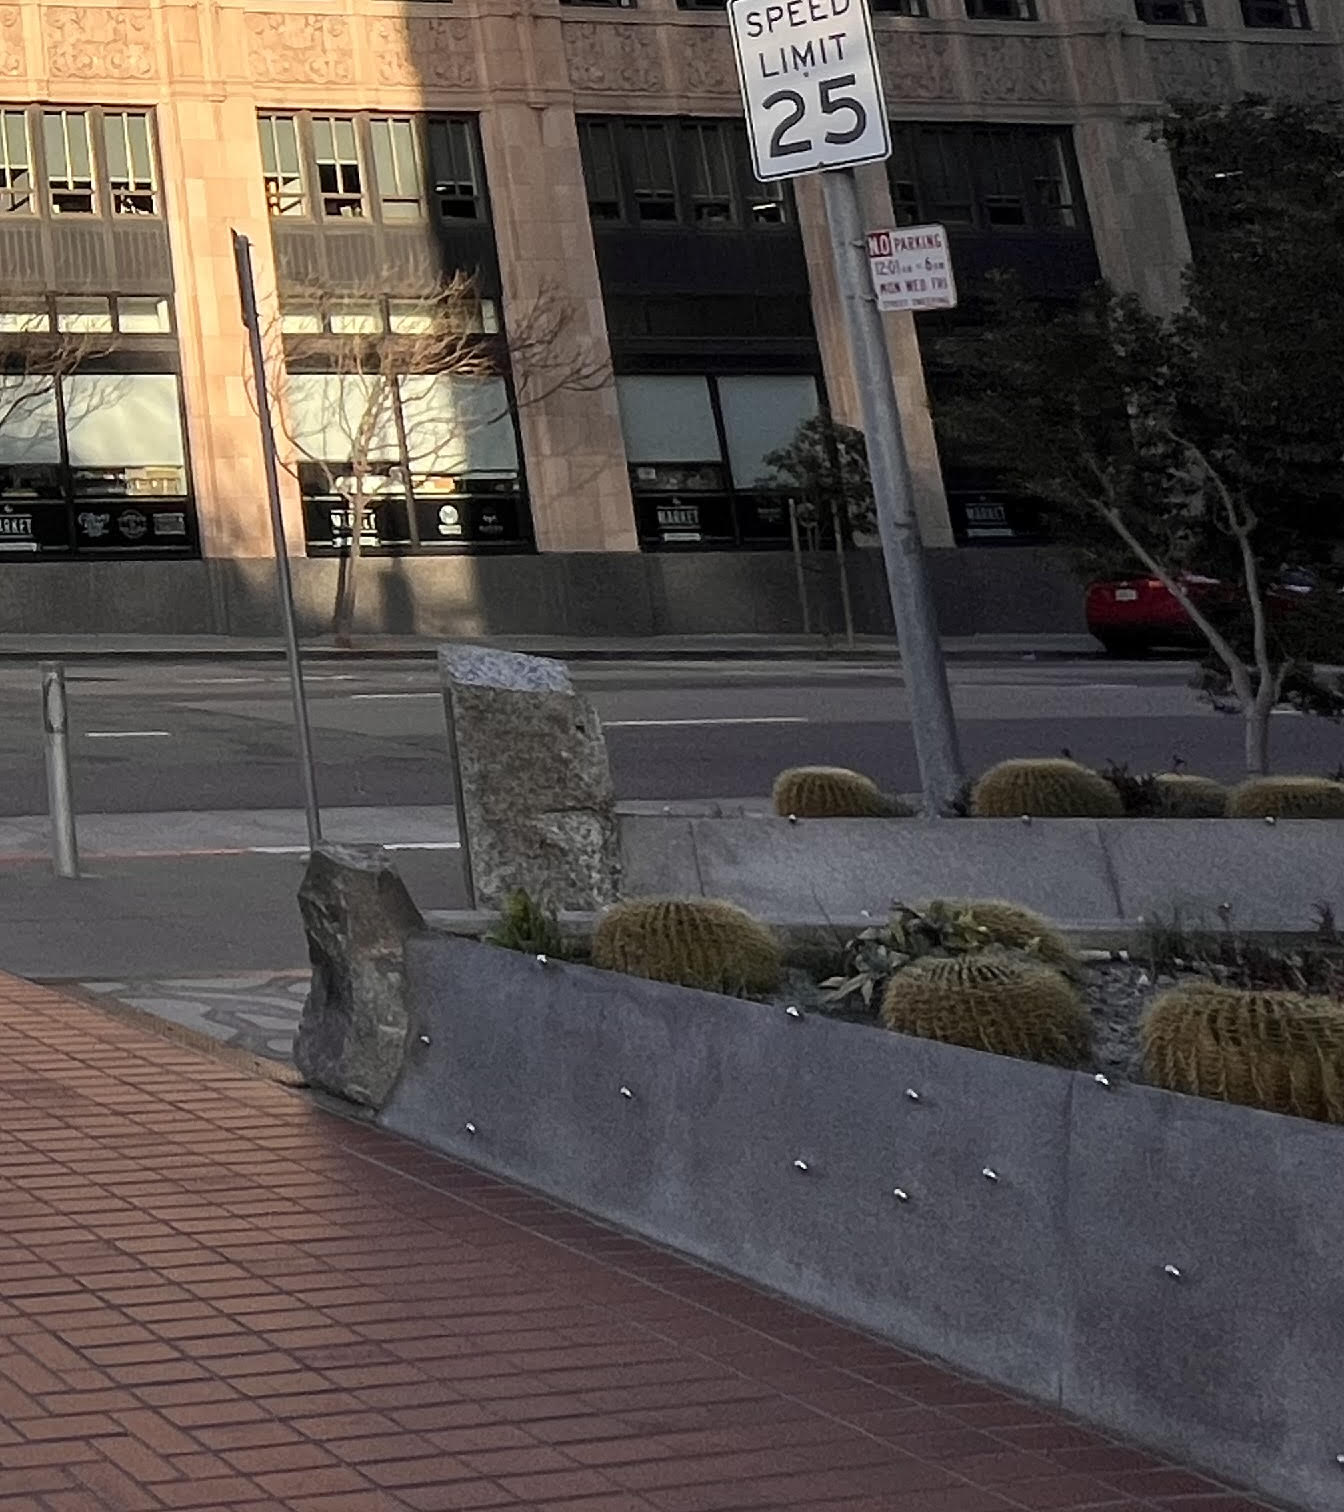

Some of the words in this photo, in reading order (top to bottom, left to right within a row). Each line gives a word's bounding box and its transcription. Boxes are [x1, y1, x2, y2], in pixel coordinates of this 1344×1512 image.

[759, 33, 847, 78] LIMIT
[762, 73, 867, 158] 25
[868, 234, 891, 256] NO
[894, 233, 942, 251] PARKING
[905, 278, 926, 292] WED
